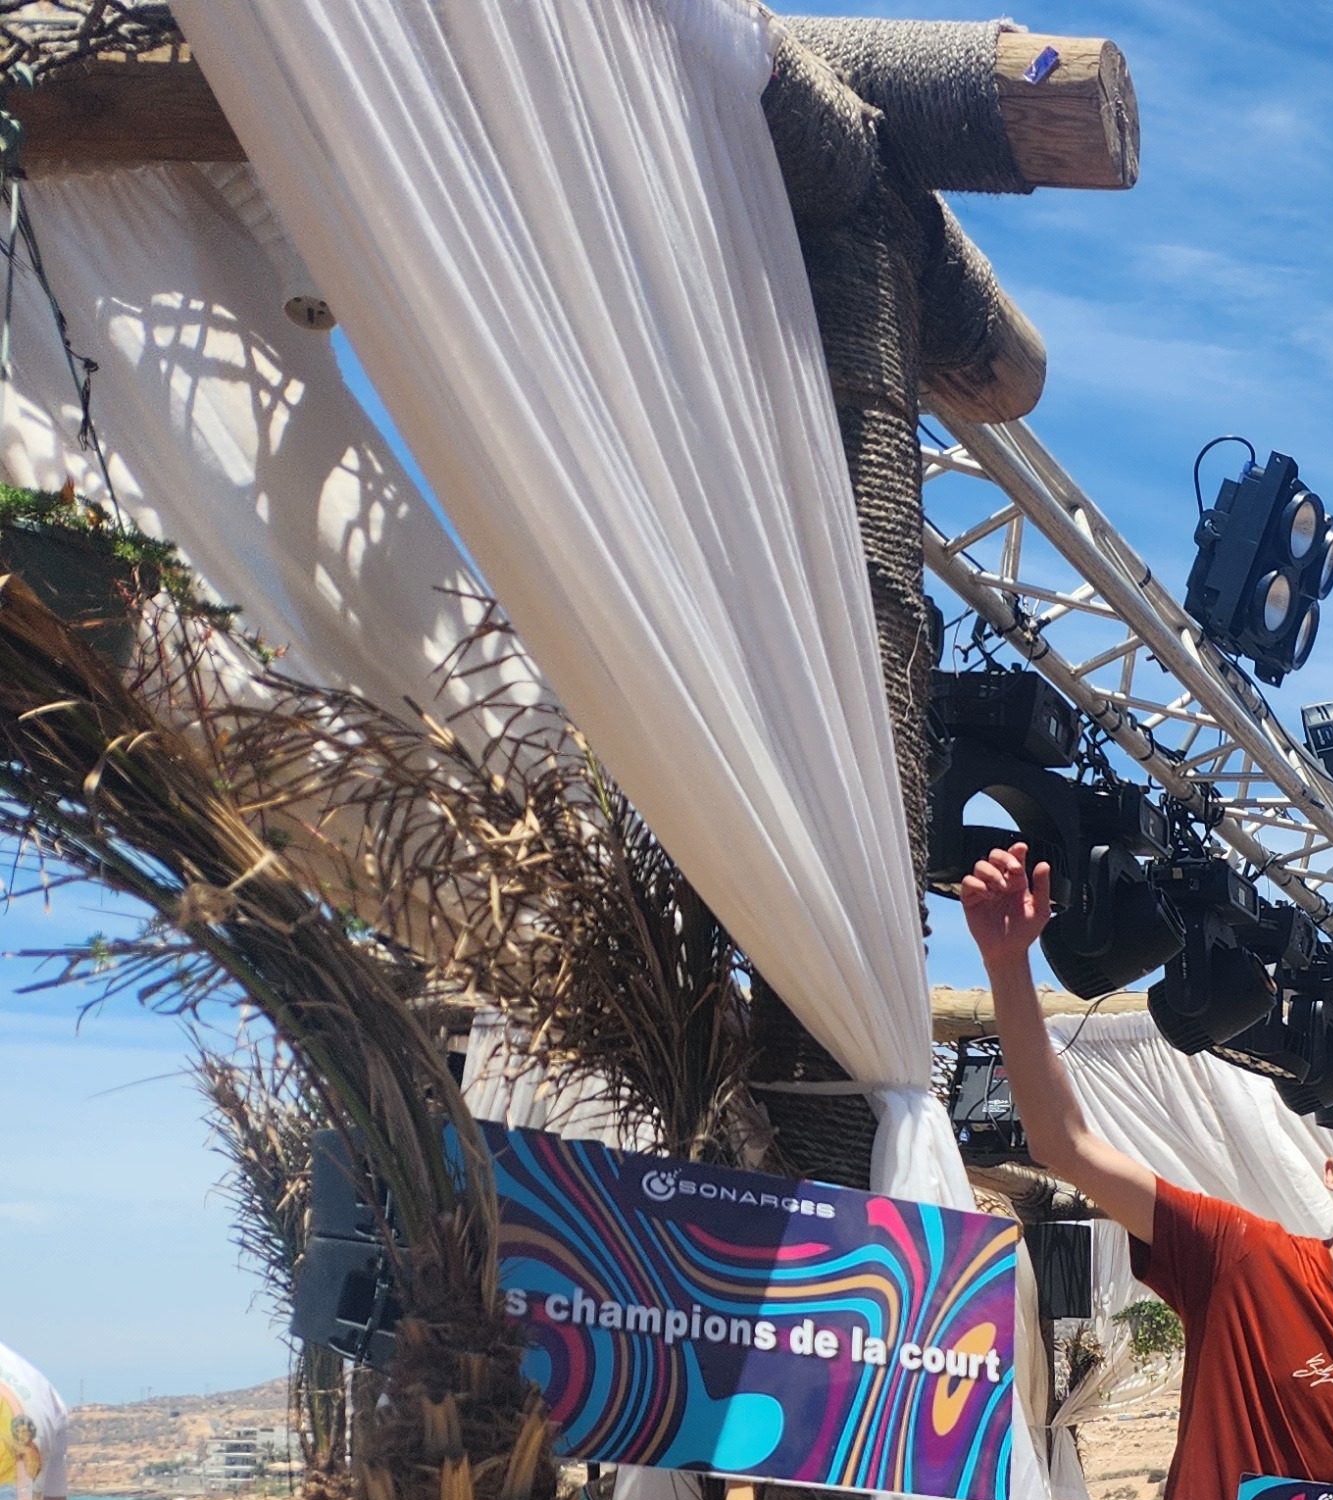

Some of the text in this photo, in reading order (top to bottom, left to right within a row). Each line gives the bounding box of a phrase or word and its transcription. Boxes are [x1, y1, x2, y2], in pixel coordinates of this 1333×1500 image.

[679, 1180, 836, 1219] SONARGES
[545, 1286, 777, 1350] champions
[789, 1319, 838, 1358] de
[851, 1332, 887, 1366] la
[899, 1344, 1000, 1382] court
